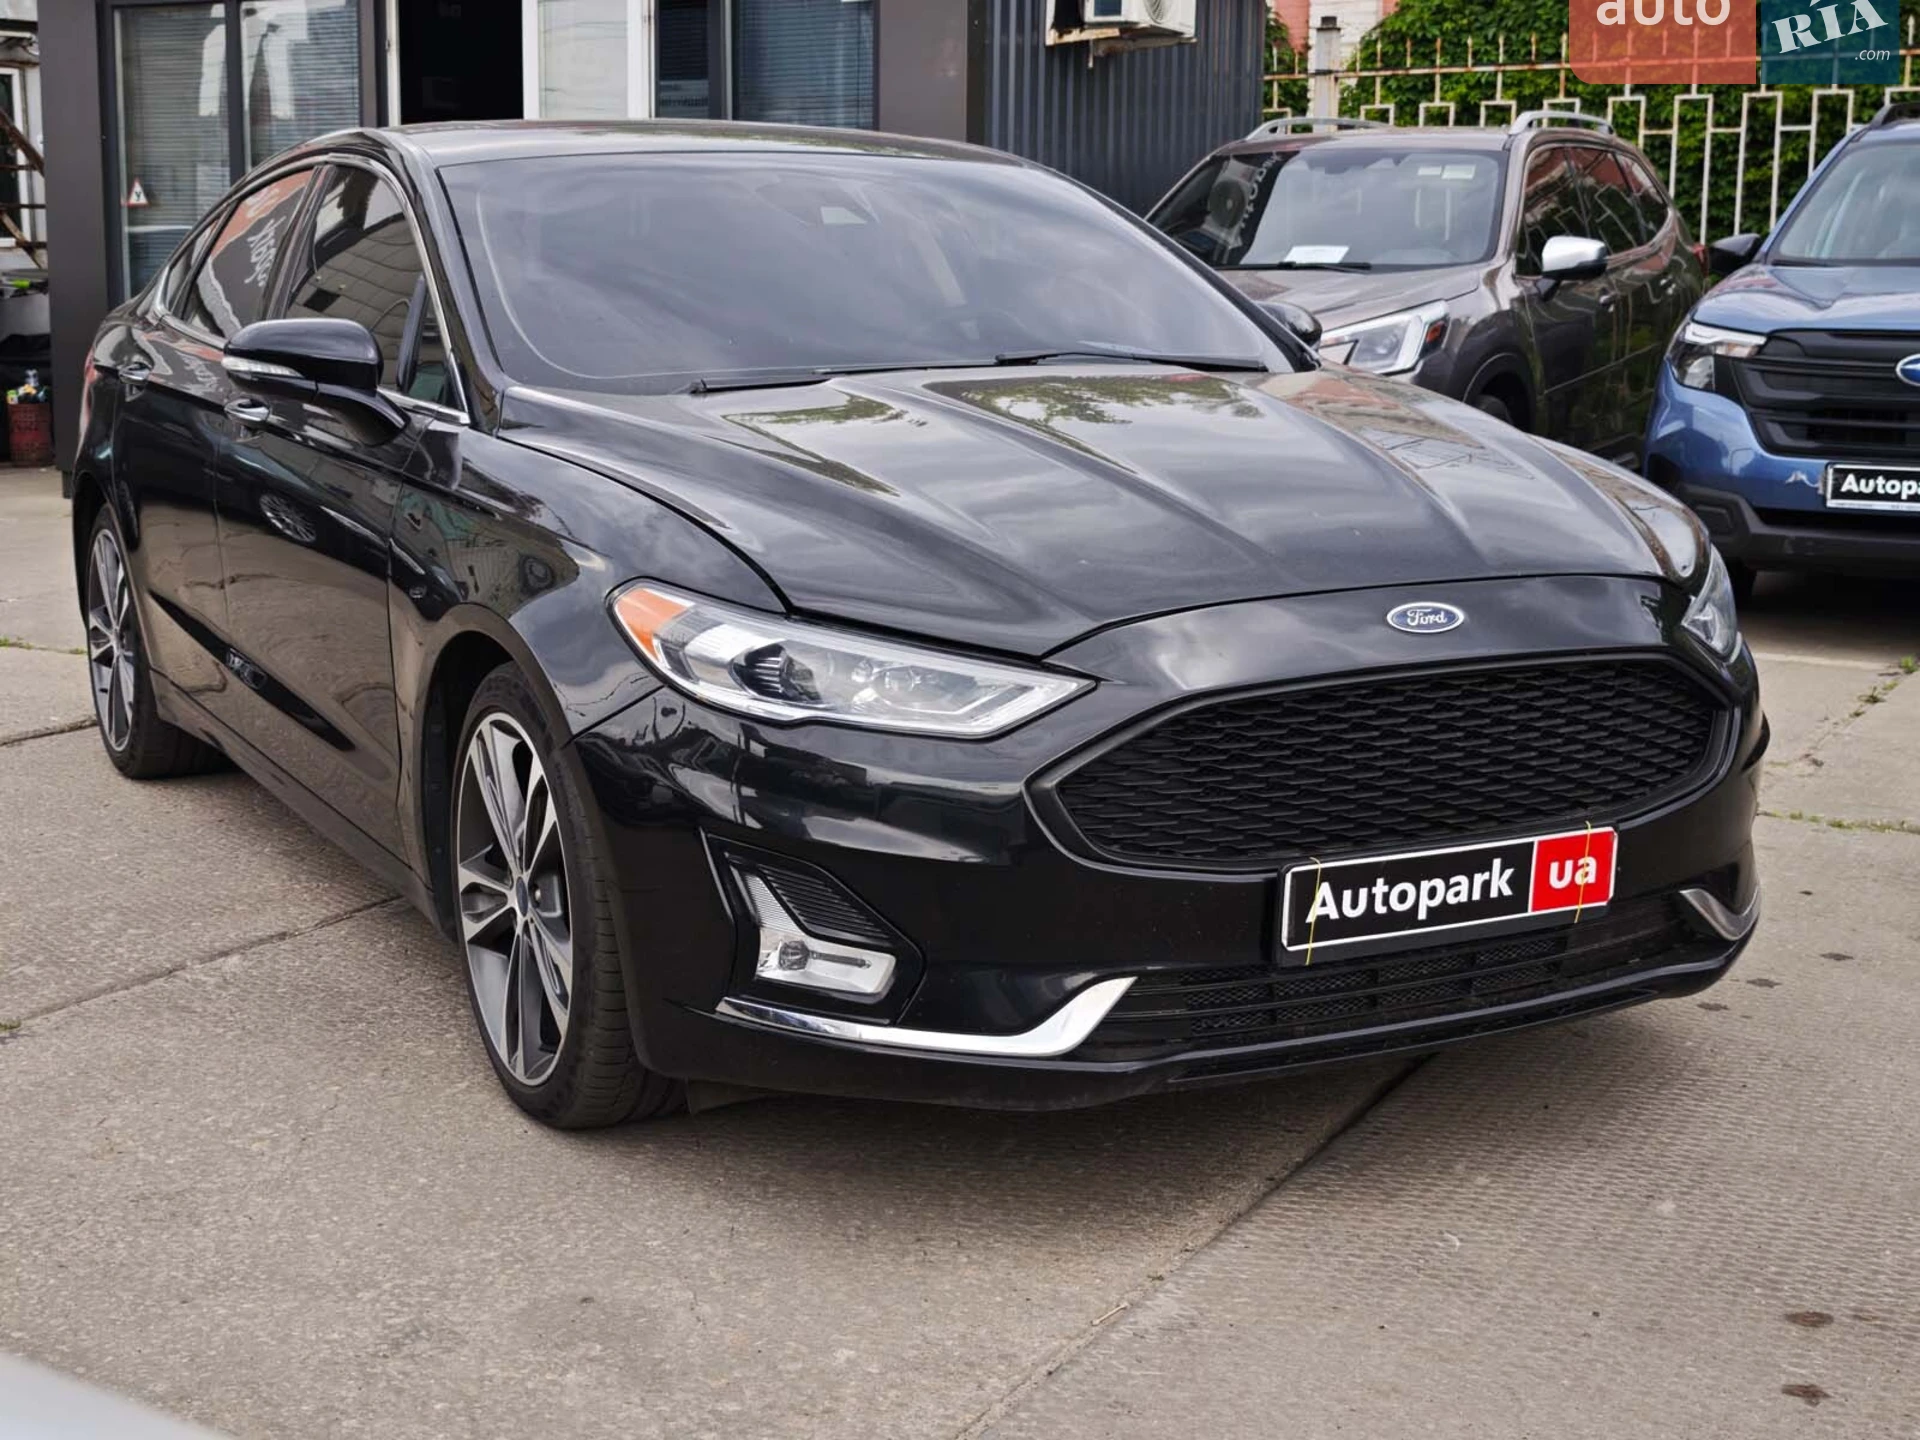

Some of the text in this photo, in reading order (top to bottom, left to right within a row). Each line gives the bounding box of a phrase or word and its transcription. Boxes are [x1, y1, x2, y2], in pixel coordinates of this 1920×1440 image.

[1840, 473, 1920, 500] Autop
[1407, 608, 1448, 626] Ford
[1305, 855, 1597, 924] Autopark ua
